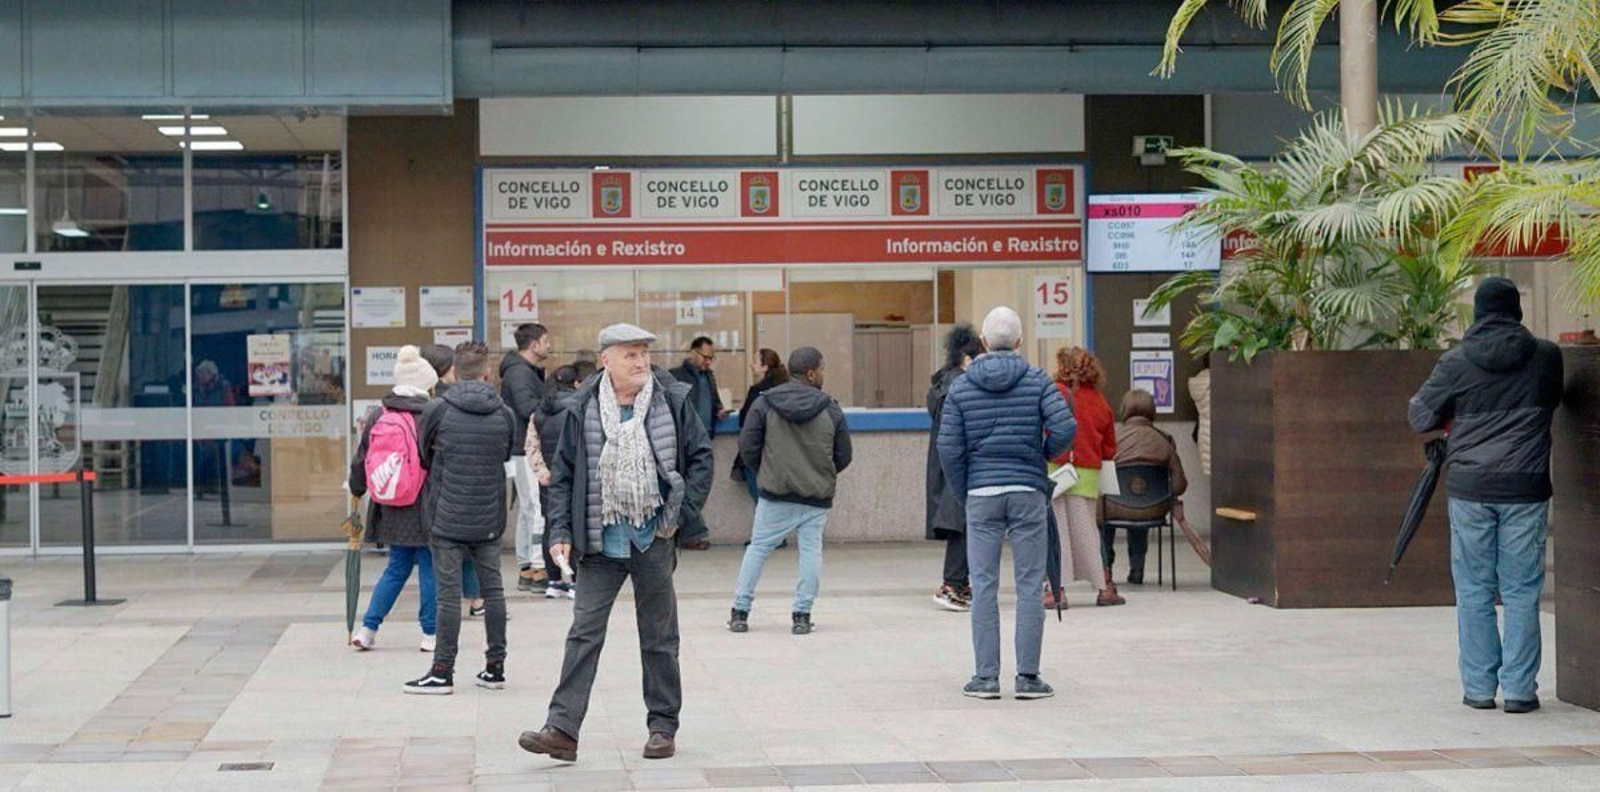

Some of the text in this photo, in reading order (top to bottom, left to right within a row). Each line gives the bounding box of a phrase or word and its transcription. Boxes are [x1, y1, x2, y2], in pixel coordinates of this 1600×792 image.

[498, 181, 580, 194] CONCELLO
[646, 180, 729, 193] CONCELLO
[798, 179, 879, 191] CONCELLO
[944, 177, 1025, 190] CONCELLO
[508, 196, 571, 209] DE VIGO
[657, 195, 719, 208] DE VIGO
[808, 194, 870, 207] DE VIGO
[954, 192, 1015, 206] DE VIGO
[1103, 205, 1141, 217] xs010
[488, 239, 685, 257] Información e Rexistro
[886, 236, 1079, 254] Información e Rexistro
[1037, 281, 1068, 305] 15
[502, 289, 534, 312] 14
[681, 307, 694, 318] 14
[259, 409, 330, 421] CONCELLO
[292, 423, 322, 433] VIGO
[370, 451, 402, 491] NIKE
